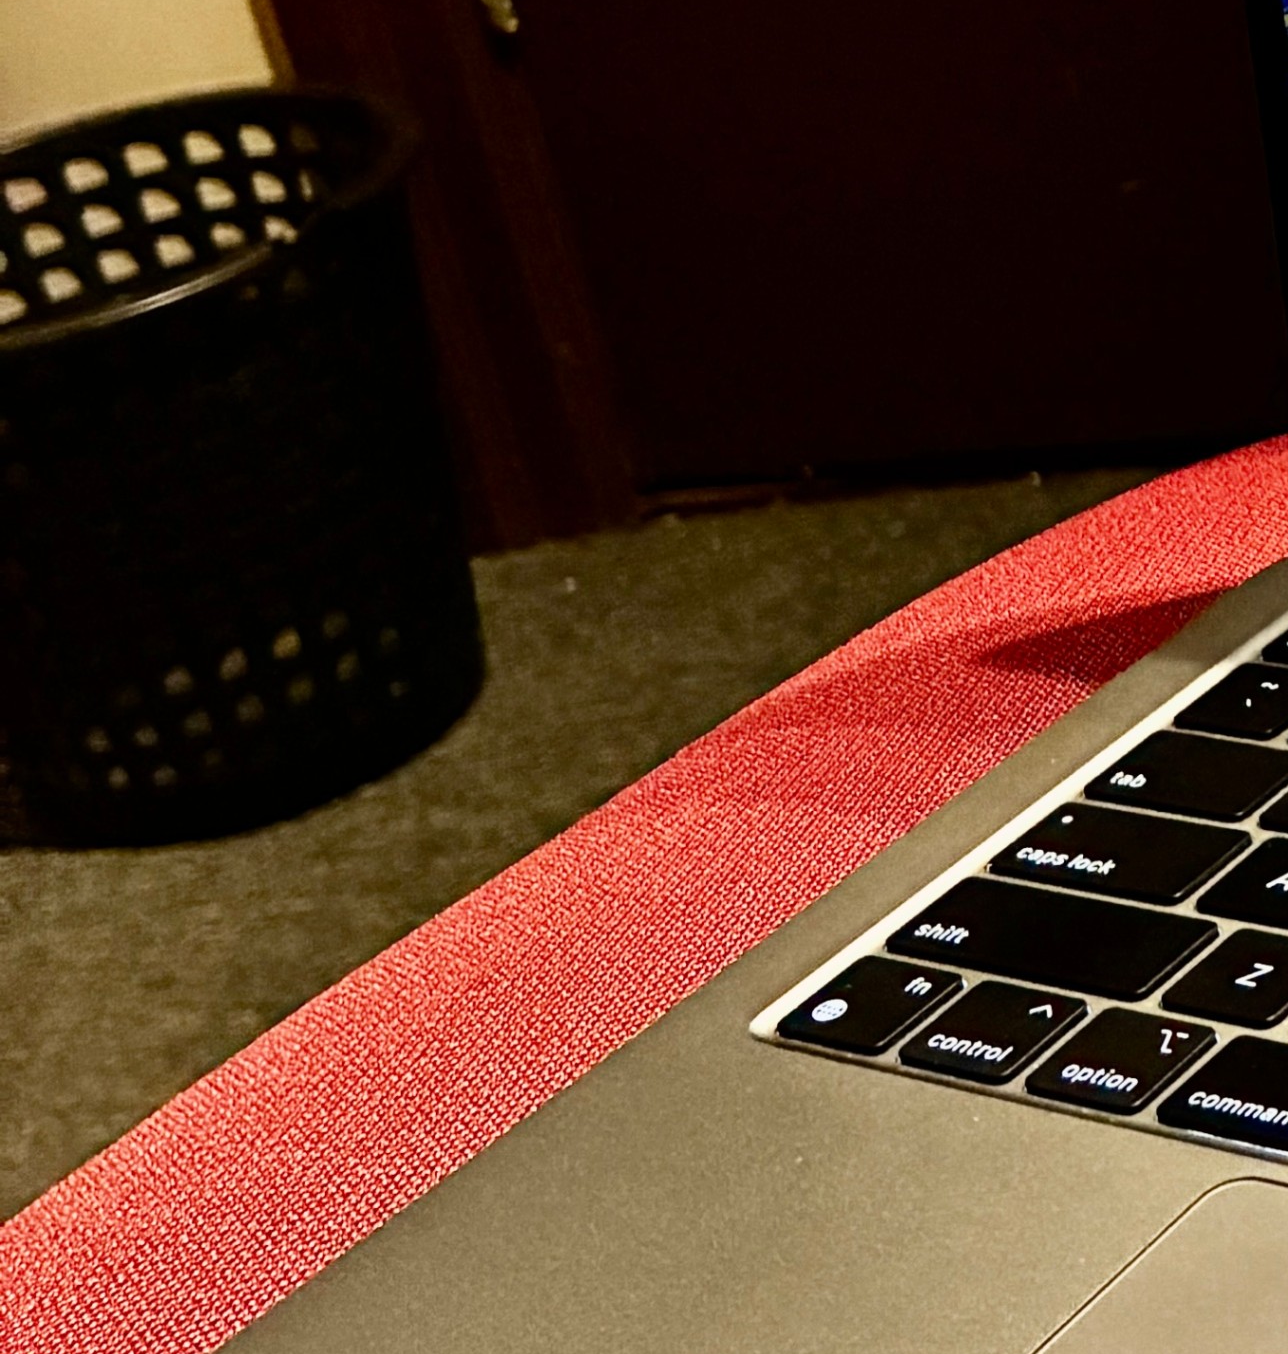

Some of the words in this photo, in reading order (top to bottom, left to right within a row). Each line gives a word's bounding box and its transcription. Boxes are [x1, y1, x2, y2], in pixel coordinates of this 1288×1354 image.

[1109, 771, 1148, 789] tab
[1016, 843, 1067, 868] caps
[1067, 853, 1117, 876] lock
[913, 921, 970, 945] shift
[904, 976, 933, 996] fn
[1234, 962, 1275, 988] Z
[927, 1033, 1014, 1062] control
[1061, 1063, 1139, 1092] option
